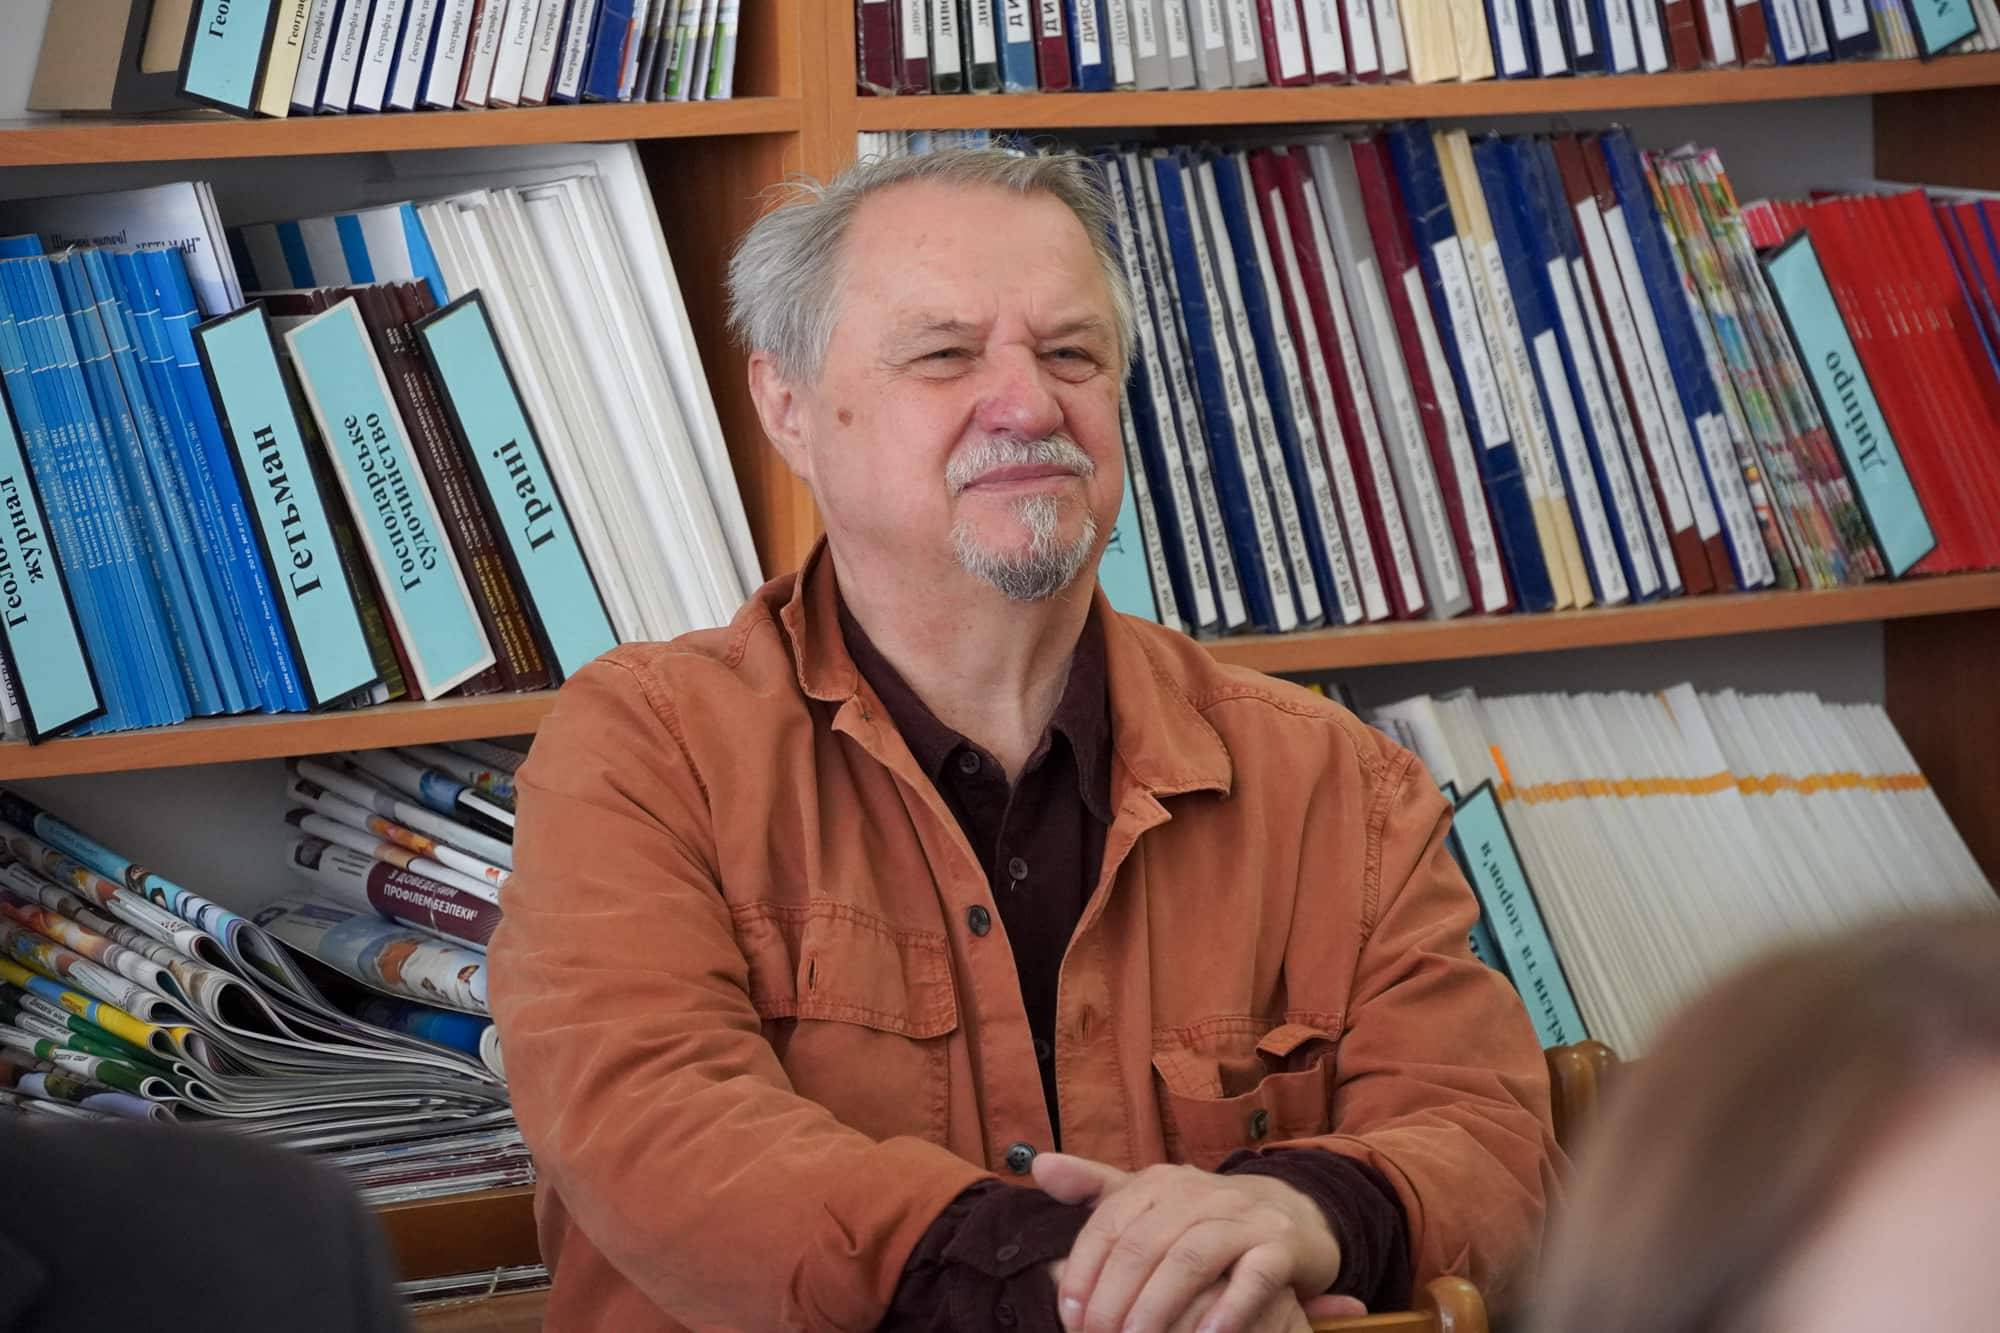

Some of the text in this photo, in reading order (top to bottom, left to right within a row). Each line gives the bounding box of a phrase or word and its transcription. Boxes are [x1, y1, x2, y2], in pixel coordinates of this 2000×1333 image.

[307, 11, 325, 61] Географія
[341, 13, 359, 62] Географія
[373, 14, 392, 63] Географія
[408, 14, 426, 63] Географія
[445, 10, 463, 60] Географія
[1825, 351, 1887, 472] Дніпро
[253, 424, 323, 600] Гетьман
[344, 415, 421, 591] Господарське
[366, 412, 436, 570] судочинство
[493, 438, 556, 551] Грані
[0, 475, 44, 584] журнал
[384, 883, 433, 908] ПРОФІЛЕМ
[1480, 841, 1524, 939] здоров'я
[1522, 945, 1537, 974] та
